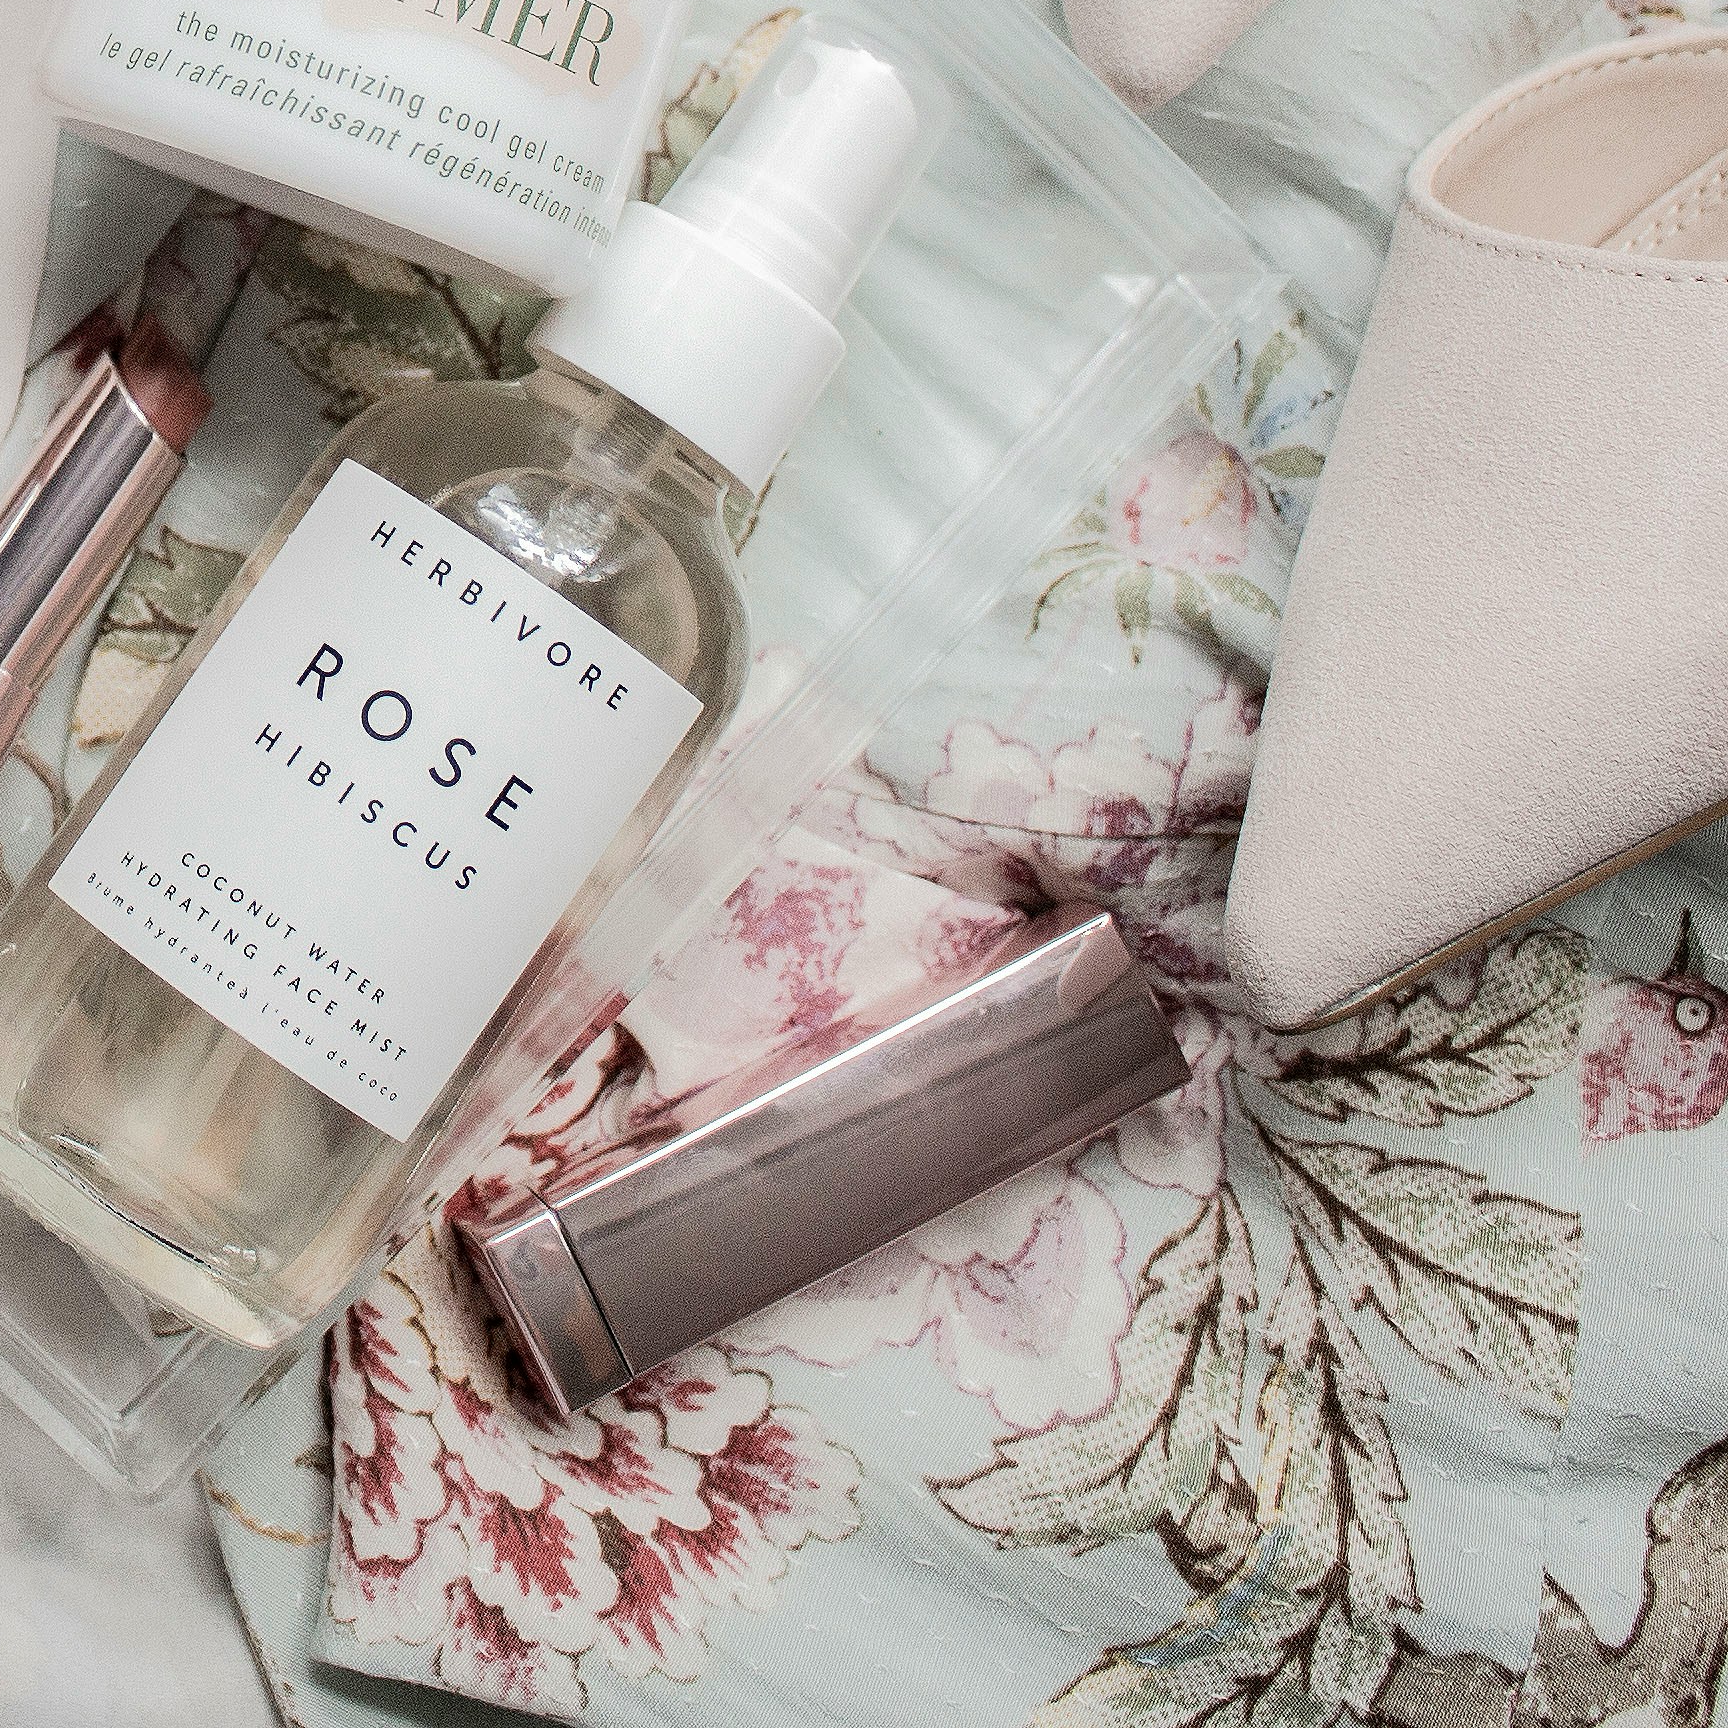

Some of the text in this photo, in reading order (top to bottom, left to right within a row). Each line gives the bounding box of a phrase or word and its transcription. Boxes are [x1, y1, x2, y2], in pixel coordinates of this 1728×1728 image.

[99, 32, 122, 59] le
[126, 48, 173, 72] gel
[175, 60, 401, 151] rafraîchissant
[408, 141, 572, 224] régénération
[175, 10, 605, 194] the moisturizing cool gel cream
[370, 520, 629, 712] HERBIVORE
[255, 723, 478, 891] HIBISCUS
[296, 642, 534, 832] ROSE
[87, 872, 135, 915] Brume
[261, 1003, 315, 1046] l'eau
[326, 1048, 348, 1068] de
[358, 1071, 398, 1102] coco
[121, 851, 407, 1062] HYDRATING FACE MIST
[181, 852, 385, 1004] COCONUT WATER
